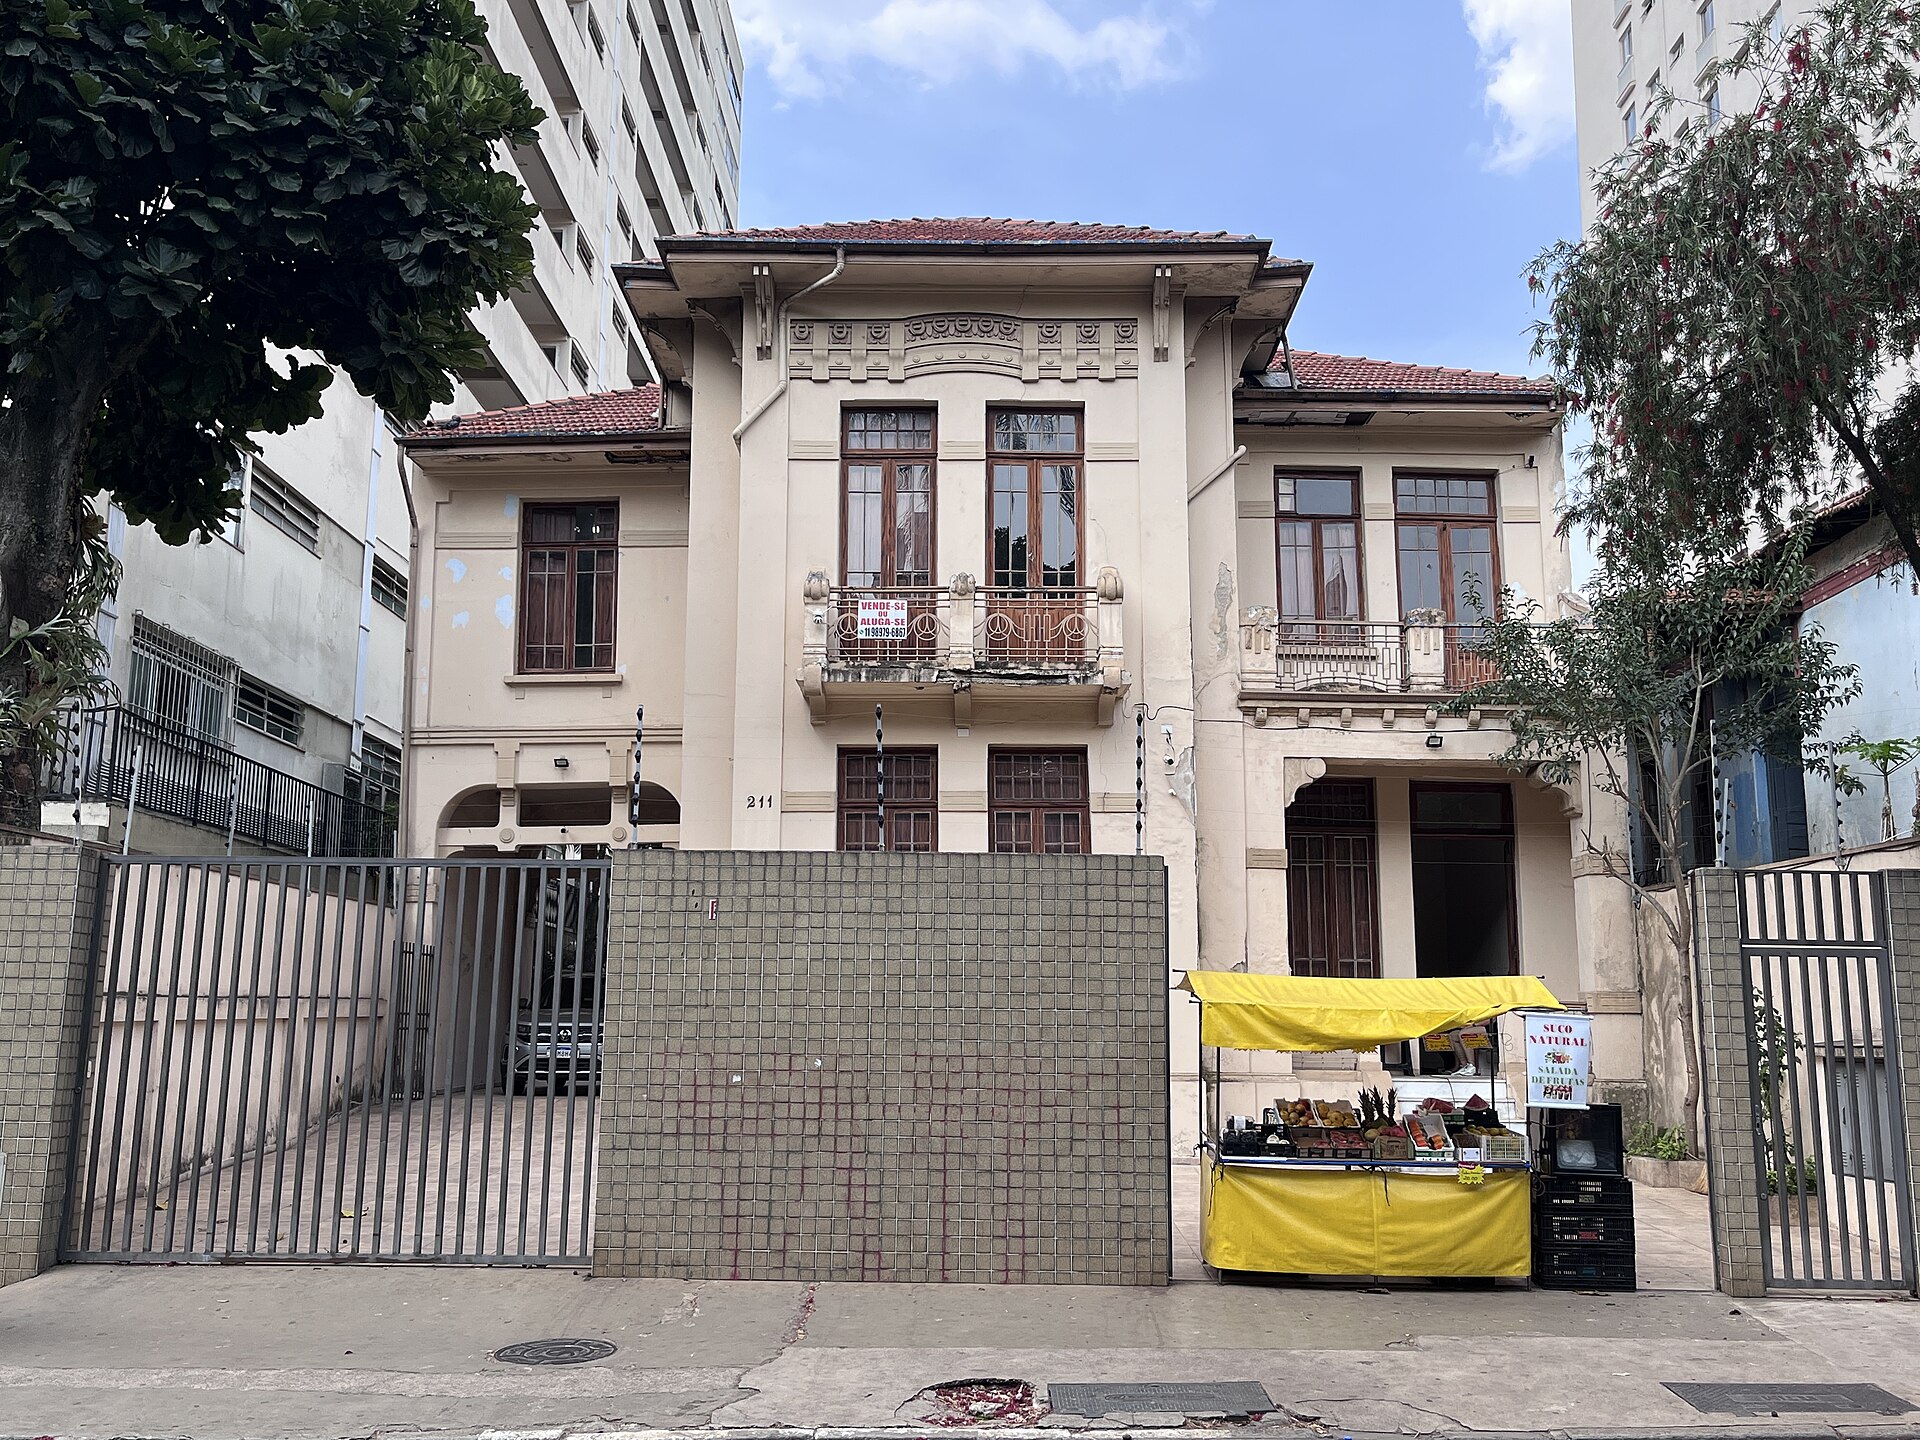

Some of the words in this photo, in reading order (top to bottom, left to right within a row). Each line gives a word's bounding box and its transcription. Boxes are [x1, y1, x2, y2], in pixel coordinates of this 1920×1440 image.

[861, 602, 905, 610] VENDE-SE
[860, 618, 905, 626] ALUGA-SE
[746, 794, 773, 809] 211
[1543, 1023, 1573, 1034] SUCO
[1529, 1035, 1588, 1047] NATURAL
[1538, 1065, 1578, 1076] SALADA
